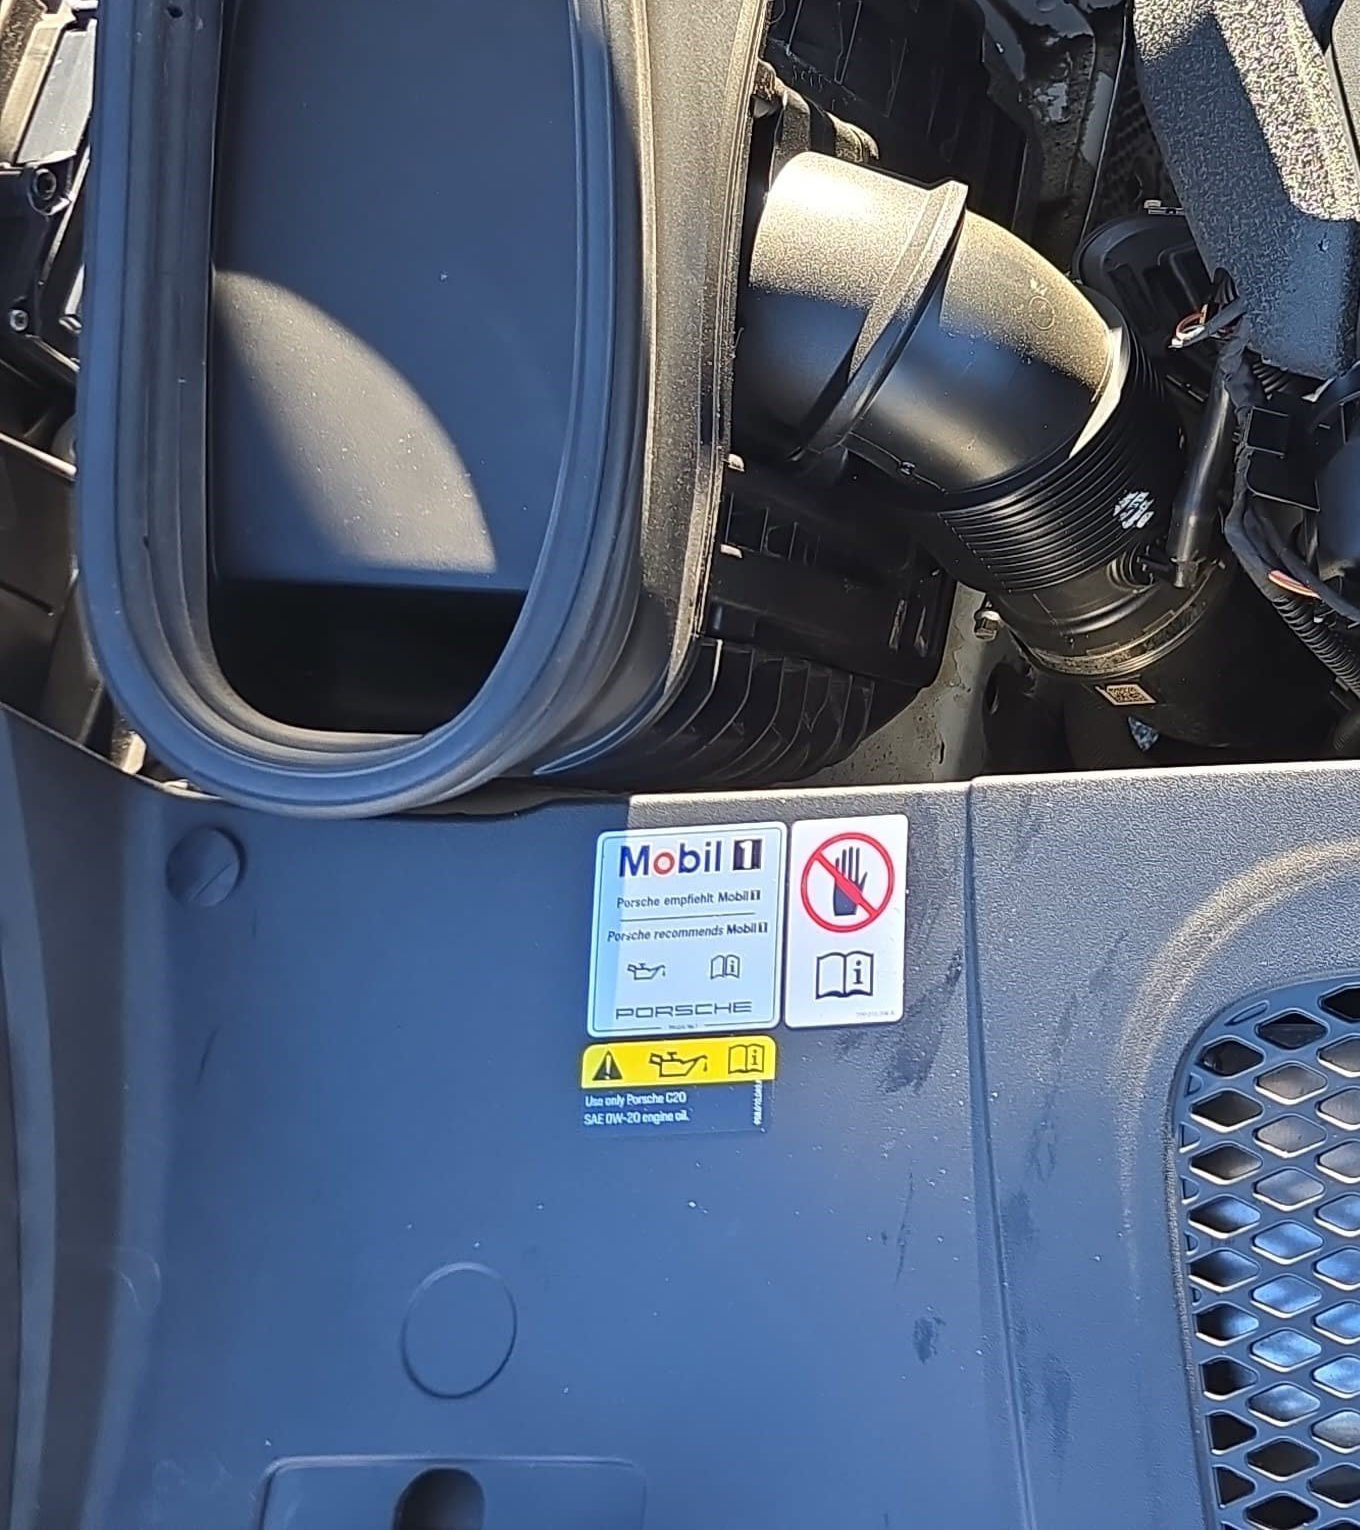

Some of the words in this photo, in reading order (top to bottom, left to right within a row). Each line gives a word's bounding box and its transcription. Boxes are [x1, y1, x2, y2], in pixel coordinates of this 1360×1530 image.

[618, 840, 722, 878] Mobil
[733, 839, 763, 871] 1
[616, 896, 660, 909] Porsche
[664, 892, 715, 907] empfiehlt
[607, 929, 653, 942] Porsche
[654, 925, 724, 940] recommends
[615, 1001, 752, 1019] PORSCHE
[604, 1095, 624, 1108] only
[626, 1093, 664, 1106] Porsche
[584, 1113, 604, 1125] SAE
[642, 1111, 673, 1124] engine
